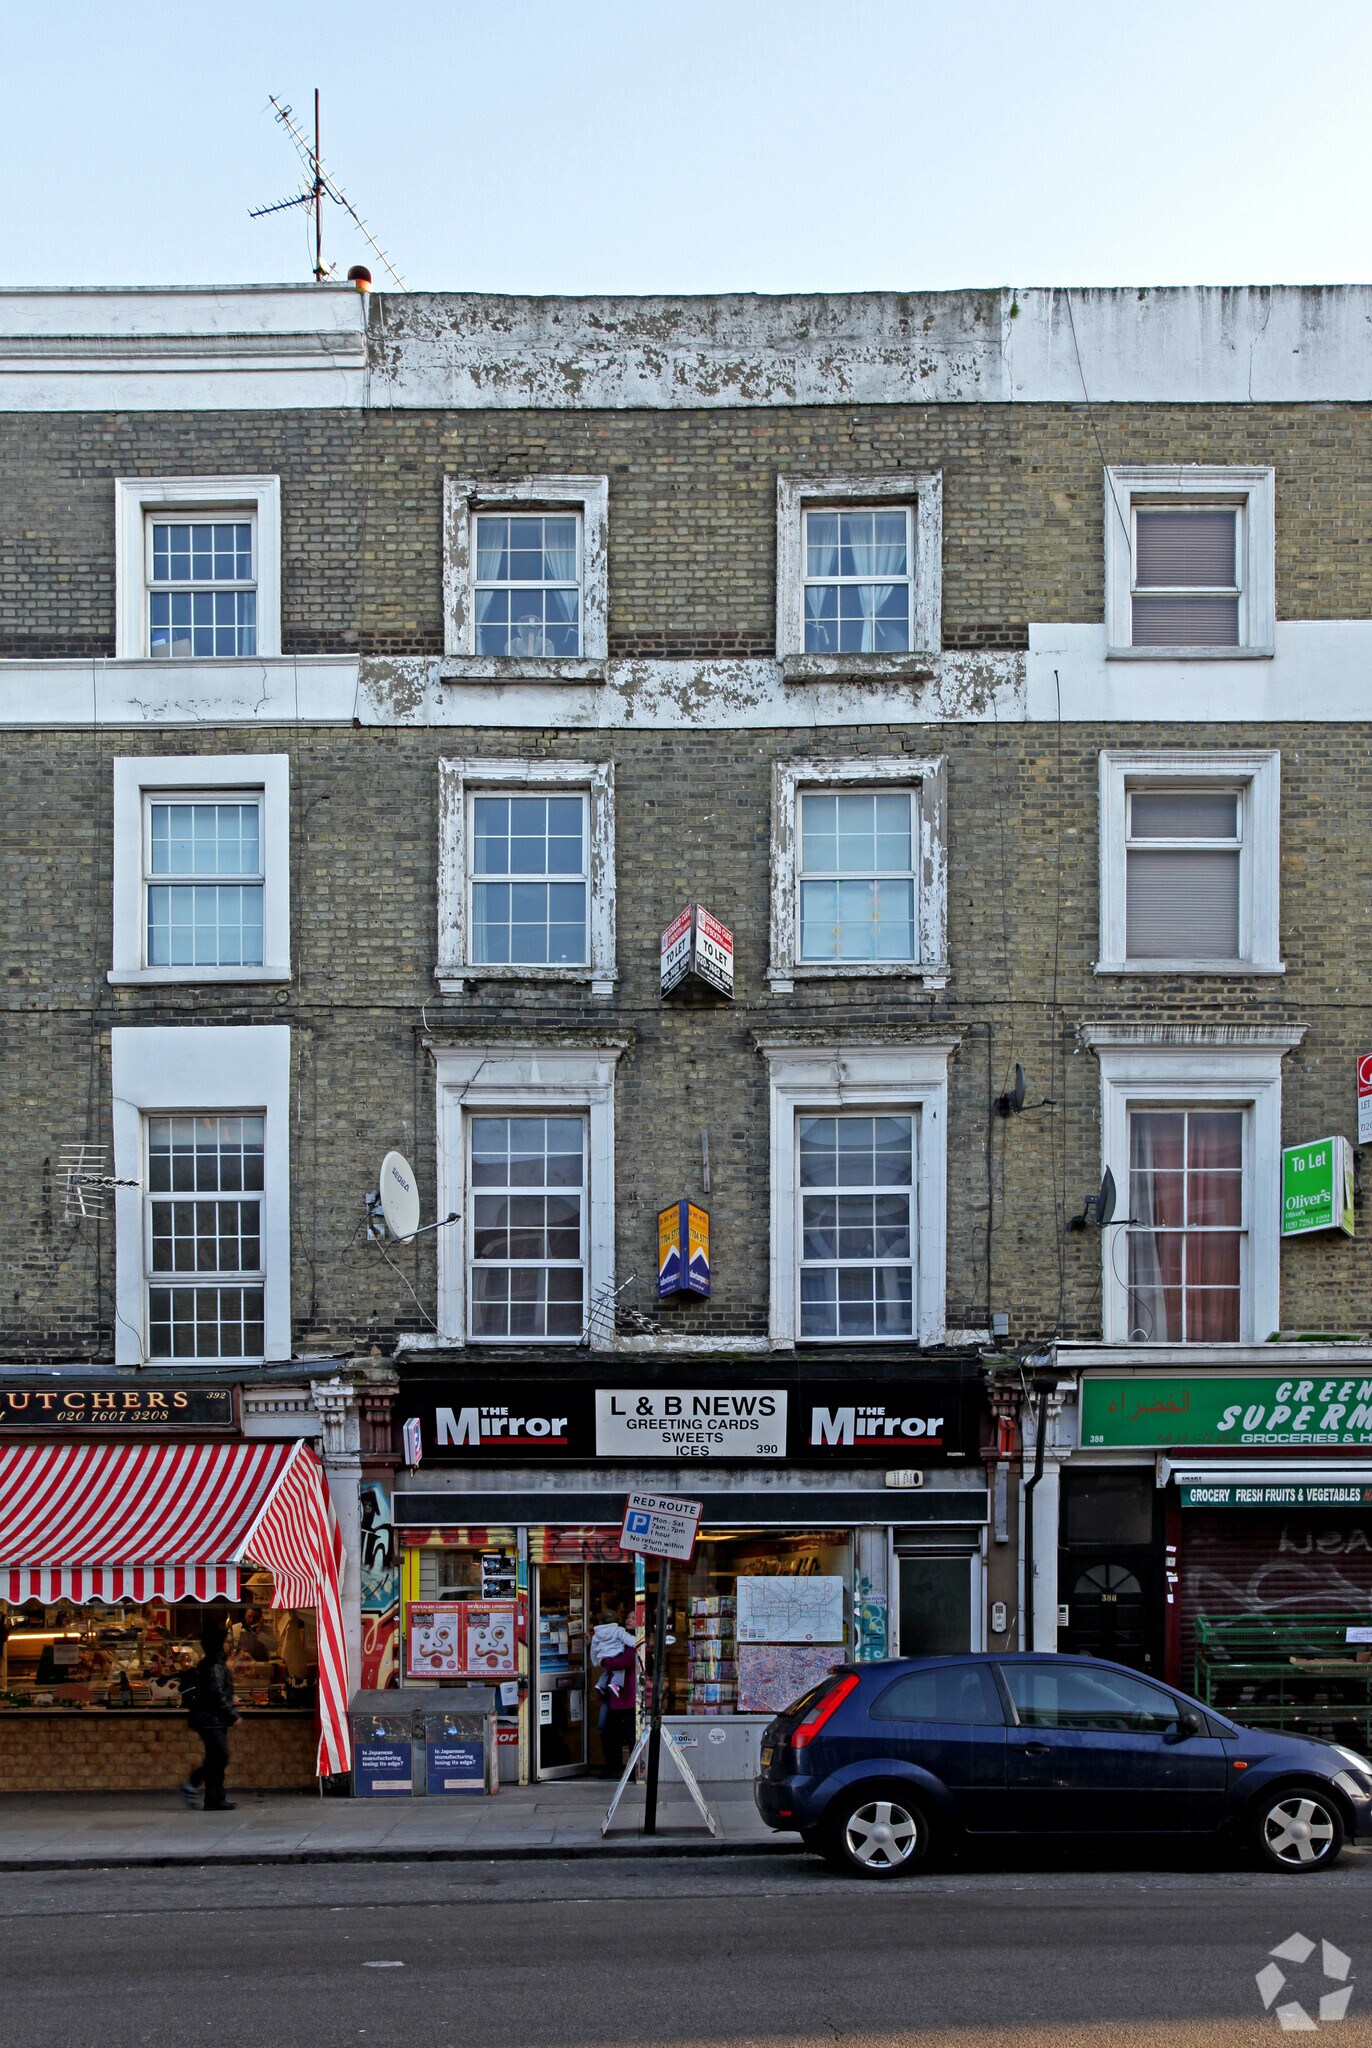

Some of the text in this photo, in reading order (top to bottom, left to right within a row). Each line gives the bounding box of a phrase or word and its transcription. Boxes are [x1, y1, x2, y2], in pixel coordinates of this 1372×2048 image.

[666, 951, 675, 966] TO
[675, 938, 686, 957] LET
[704, 940, 713, 956] TO
[715, 949, 727, 967] LET
[1361, 1100, 1371, 1110] LET
[1292, 1151, 1326, 1173] To Let
[1286, 1189, 1331, 1210] Oliver's
[0, 1391, 189, 1409] UTCHERS
[206, 1392, 226, 1400] 392
[480, 1407, 509, 1415] THE
[611, 1396, 776, 1417] L & B NEWS
[857, 1407, 886, 1415] THE
[57, 1410, 169, 1422] 020 7607 3208
[435, 1407, 568, 1445] Mirror
[626, 1419, 760, 1430] GREETING CARDS
[811, 1407, 944, 1445] Mirror
[662, 1432, 724, 1443] SWEETS
[1090, 1435, 1104, 1443] 388
[1241, 1433, 1339, 1443] GROCERIES
[1343, 1433, 1355, 1443] &
[676, 1445, 710, 1456] ICES
[756, 1444, 778, 1454] 390
[1190, 1489, 1231, 1502] GROCERY
[1235, 1489, 1263, 1502] FRESH
[1265, 1488, 1296, 1502] FRUITS
[1297, 1488, 1304, 1501] &
[1306, 1488, 1361, 1501] VEGETABLES
[633, 1496, 697, 1515] RED ROUTE
[652, 1516, 667, 1524] Mon
[652, 1523, 666, 1531] 7am
[655, 1530, 671, 1538] hour
[641, 1538, 662, 1546] return
[664, 1541, 685, 1550] within
[649, 1544, 668, 1553] hours
[1101, 1594, 1117, 1602] 388
